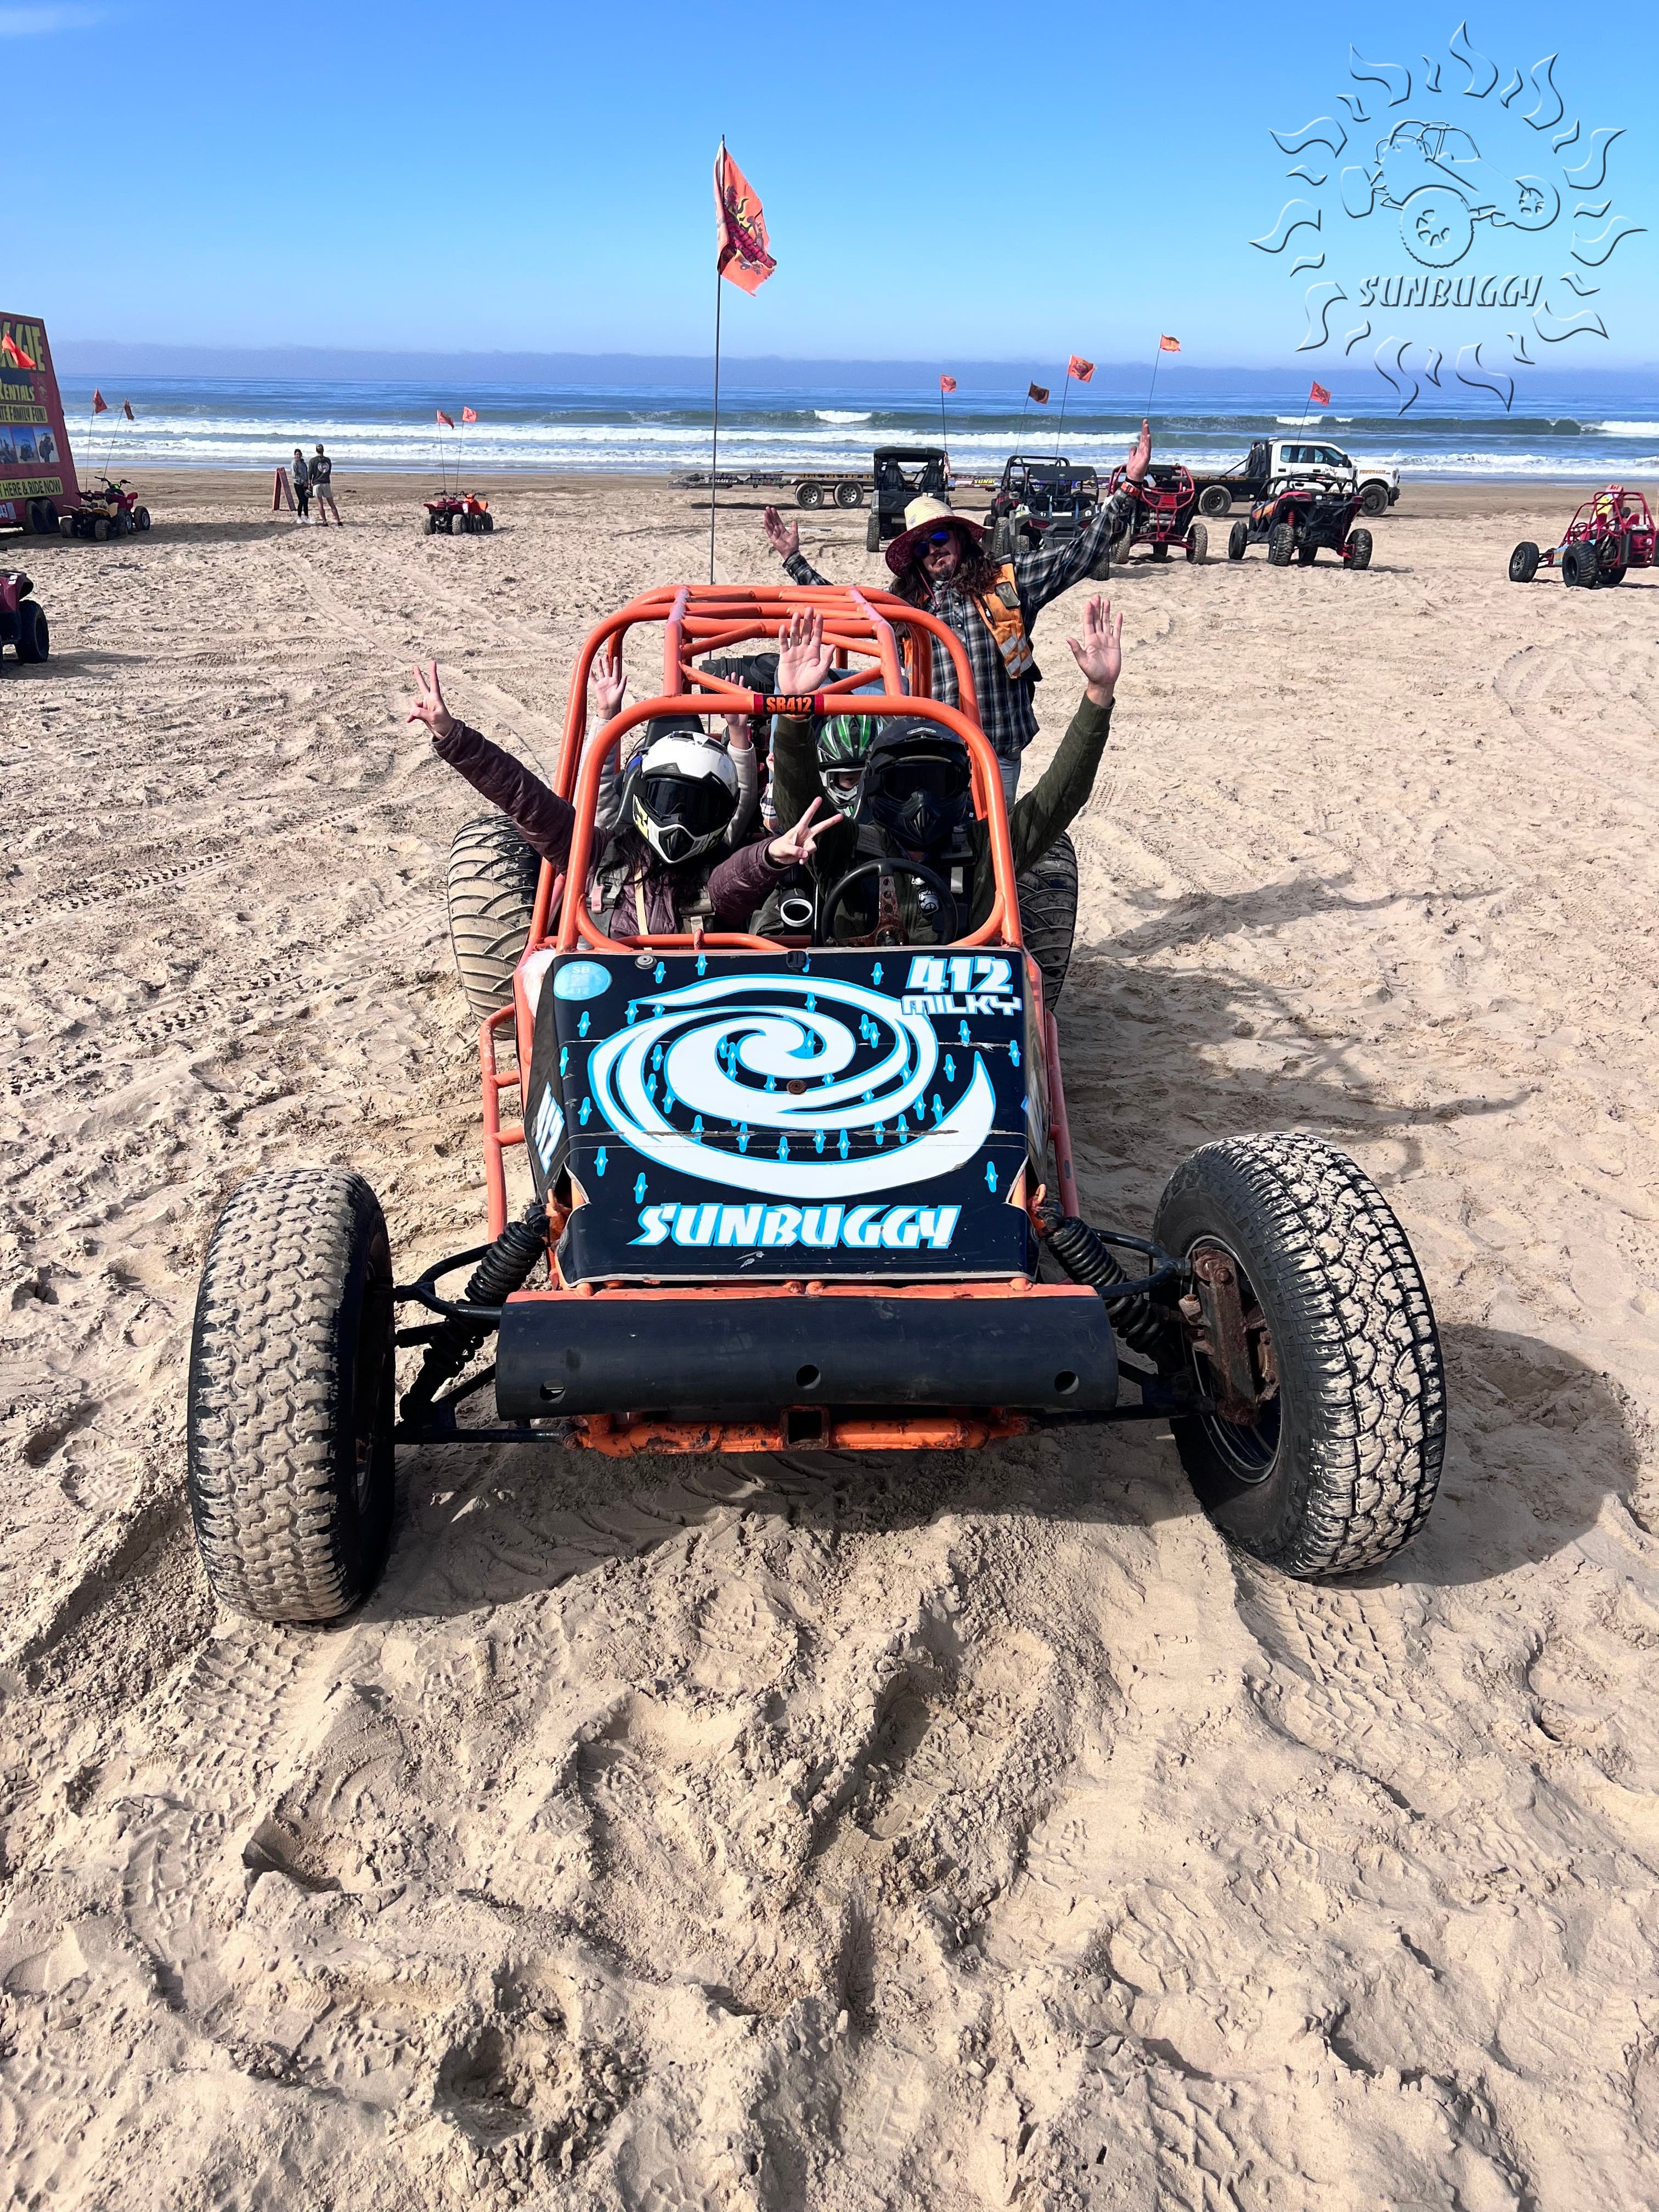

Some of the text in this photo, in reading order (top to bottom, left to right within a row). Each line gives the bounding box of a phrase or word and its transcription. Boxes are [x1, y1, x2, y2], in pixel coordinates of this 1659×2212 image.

[3, 482, 22, 496] HERE
[22, 482, 29, 494] &
[27, 481, 44, 494] RIDE
[43, 479, 61, 493] NOW
[766, 697, 811, 712] SB412
[572, 966, 590, 974] SB
[906, 956, 1013, 994] 412
[901, 995, 1023, 1015] MILKY
[627, 1203, 962, 1248] SUNBUGGY
